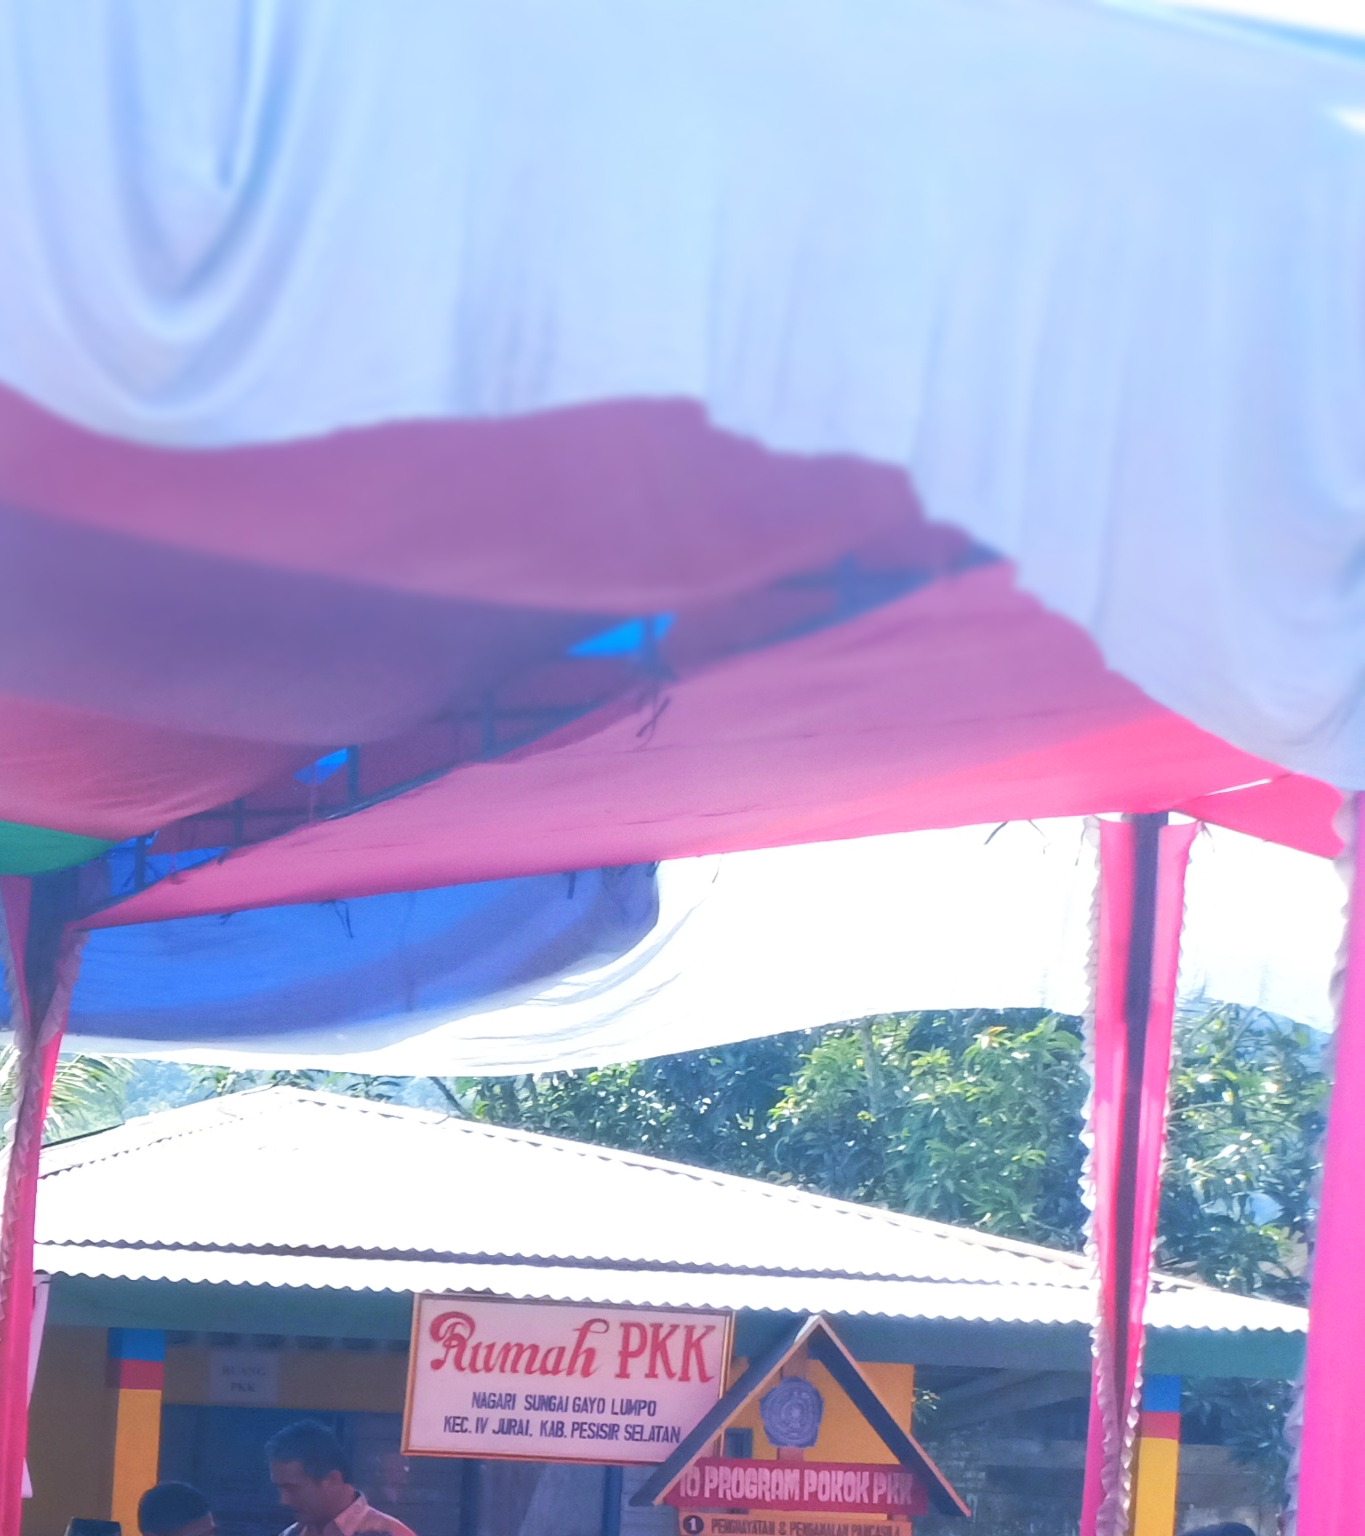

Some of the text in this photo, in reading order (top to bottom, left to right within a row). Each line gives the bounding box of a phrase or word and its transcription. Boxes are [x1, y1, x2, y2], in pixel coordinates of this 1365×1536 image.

[429, 1311, 716, 1383] Rumah PKK
[471, 1391, 657, 1417] NAGARI SUNGAI GAYO LUMPO
[443, 1416, 472, 1433] KEC.
[475, 1417, 489, 1434] IV
[540, 1421, 567, 1439] KAB.
[571, 1422, 619, 1441] PESISIR
[624, 1424, 680, 1444] SELATAN
[704, 1465, 800, 1502] PROGRAM
[804, 1469, 869, 1504] POKOK
[872, 1472, 913, 1505] PKK
[711, 1518, 775, 1536] PENGHAYATAN
